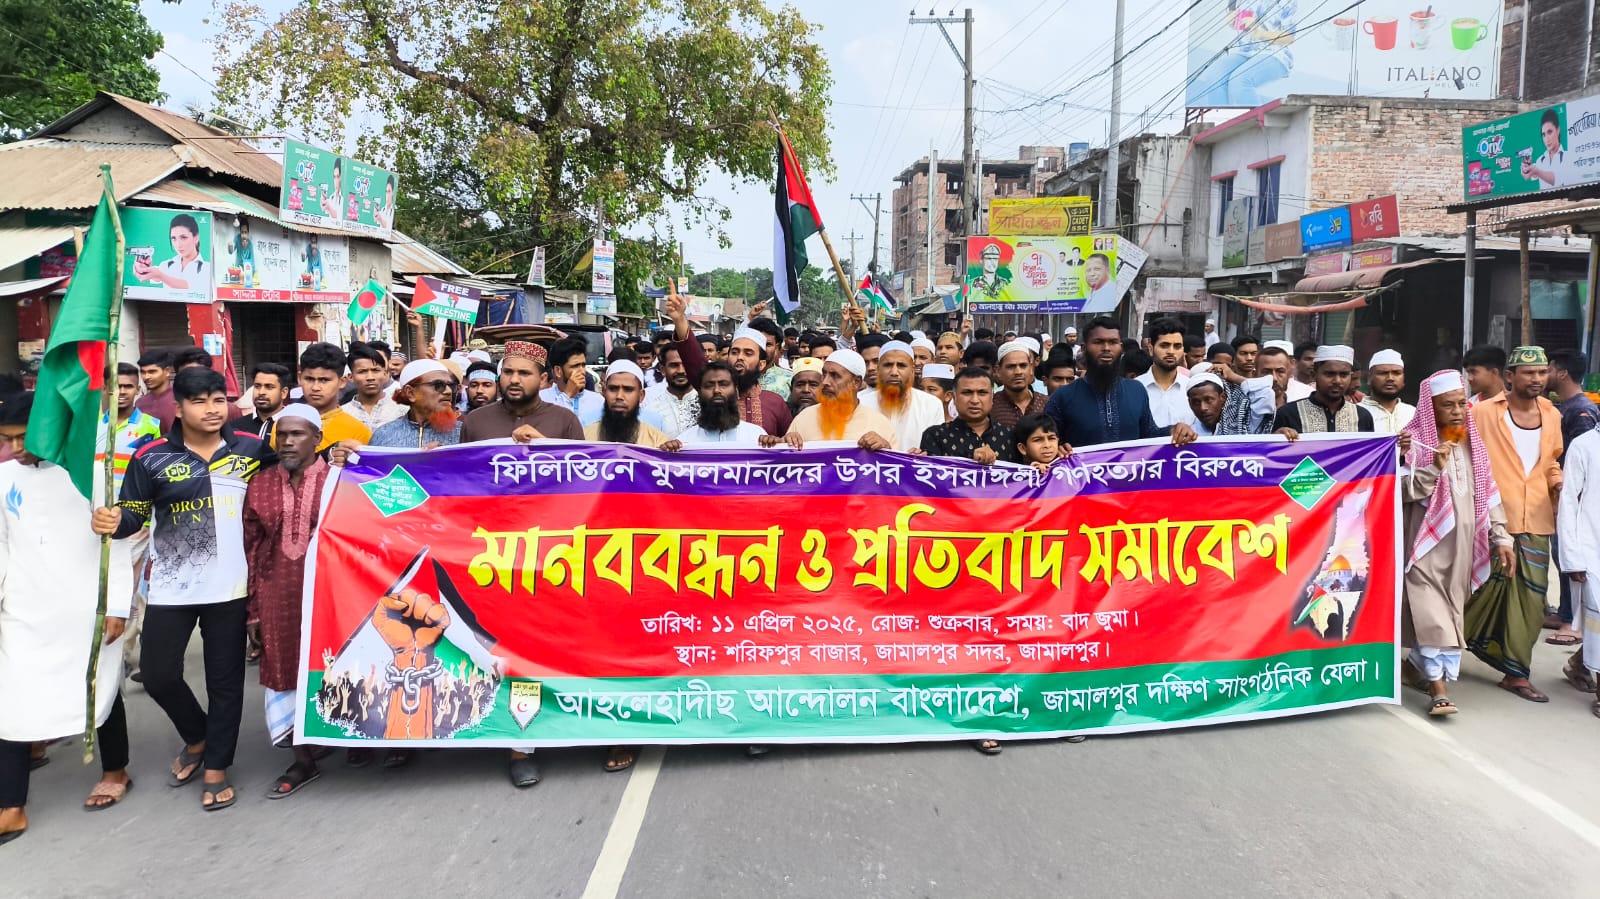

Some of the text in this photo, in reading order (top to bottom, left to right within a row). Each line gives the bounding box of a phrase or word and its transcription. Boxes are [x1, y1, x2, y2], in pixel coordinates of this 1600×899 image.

[1387, 66, 1481, 81] ITALIANO
[1072, 217, 1089, 225] CADET
[1368, 203, 1383, 224] রবি
[440, 283, 469, 297] FREE
[429, 305, 472, 320] PALESTINE
[228, 456, 248, 472] 75
[490, 452, 641, 485] ফিলিস্তিনে
[650, 459, 825, 490] মুসলমানদের
[834, 455, 904, 487] উপর
[1052, 457, 1167, 487] গণহত্যার
[1174, 450, 1266, 480] বিরুদ্ধে
[468, 503, 1292, 599] মানববন্ধন ও প্রতিবাদ সমাবেশ
[640, 610, 702, 634] তারিখ:
[712, 616, 735, 633] ১১
[744, 610, 795, 633] এপ্রিল
[803, 615, 863, 635] ২০২৫,
[871, 612, 920, 633] রোজ:
[929, 612, 999, 636] শুক্রবার,
[1007, 615, 1052, 633] সময়:
[1061, 613, 1089, 631] বাদ
[673, 644, 716, 667] স্থান:
[725, 640, 802, 666] শরিফপুর
[809, 644, 868, 665] বাজার,
[875, 641, 958, 667] জামালপুর
[965, 644, 1011, 665] সদর,
[554, 678, 740, 723] আহলেহাদীছ
[746, 685, 880, 721] আন্দোলন
[888, 682, 1030, 722] বাংলাদেশ,
[1042, 682, 1139, 713] জামালপুর
[1145, 672, 1210, 703] দক্ষিণ
[1218, 661, 1314, 697] সাংগঠনিক
